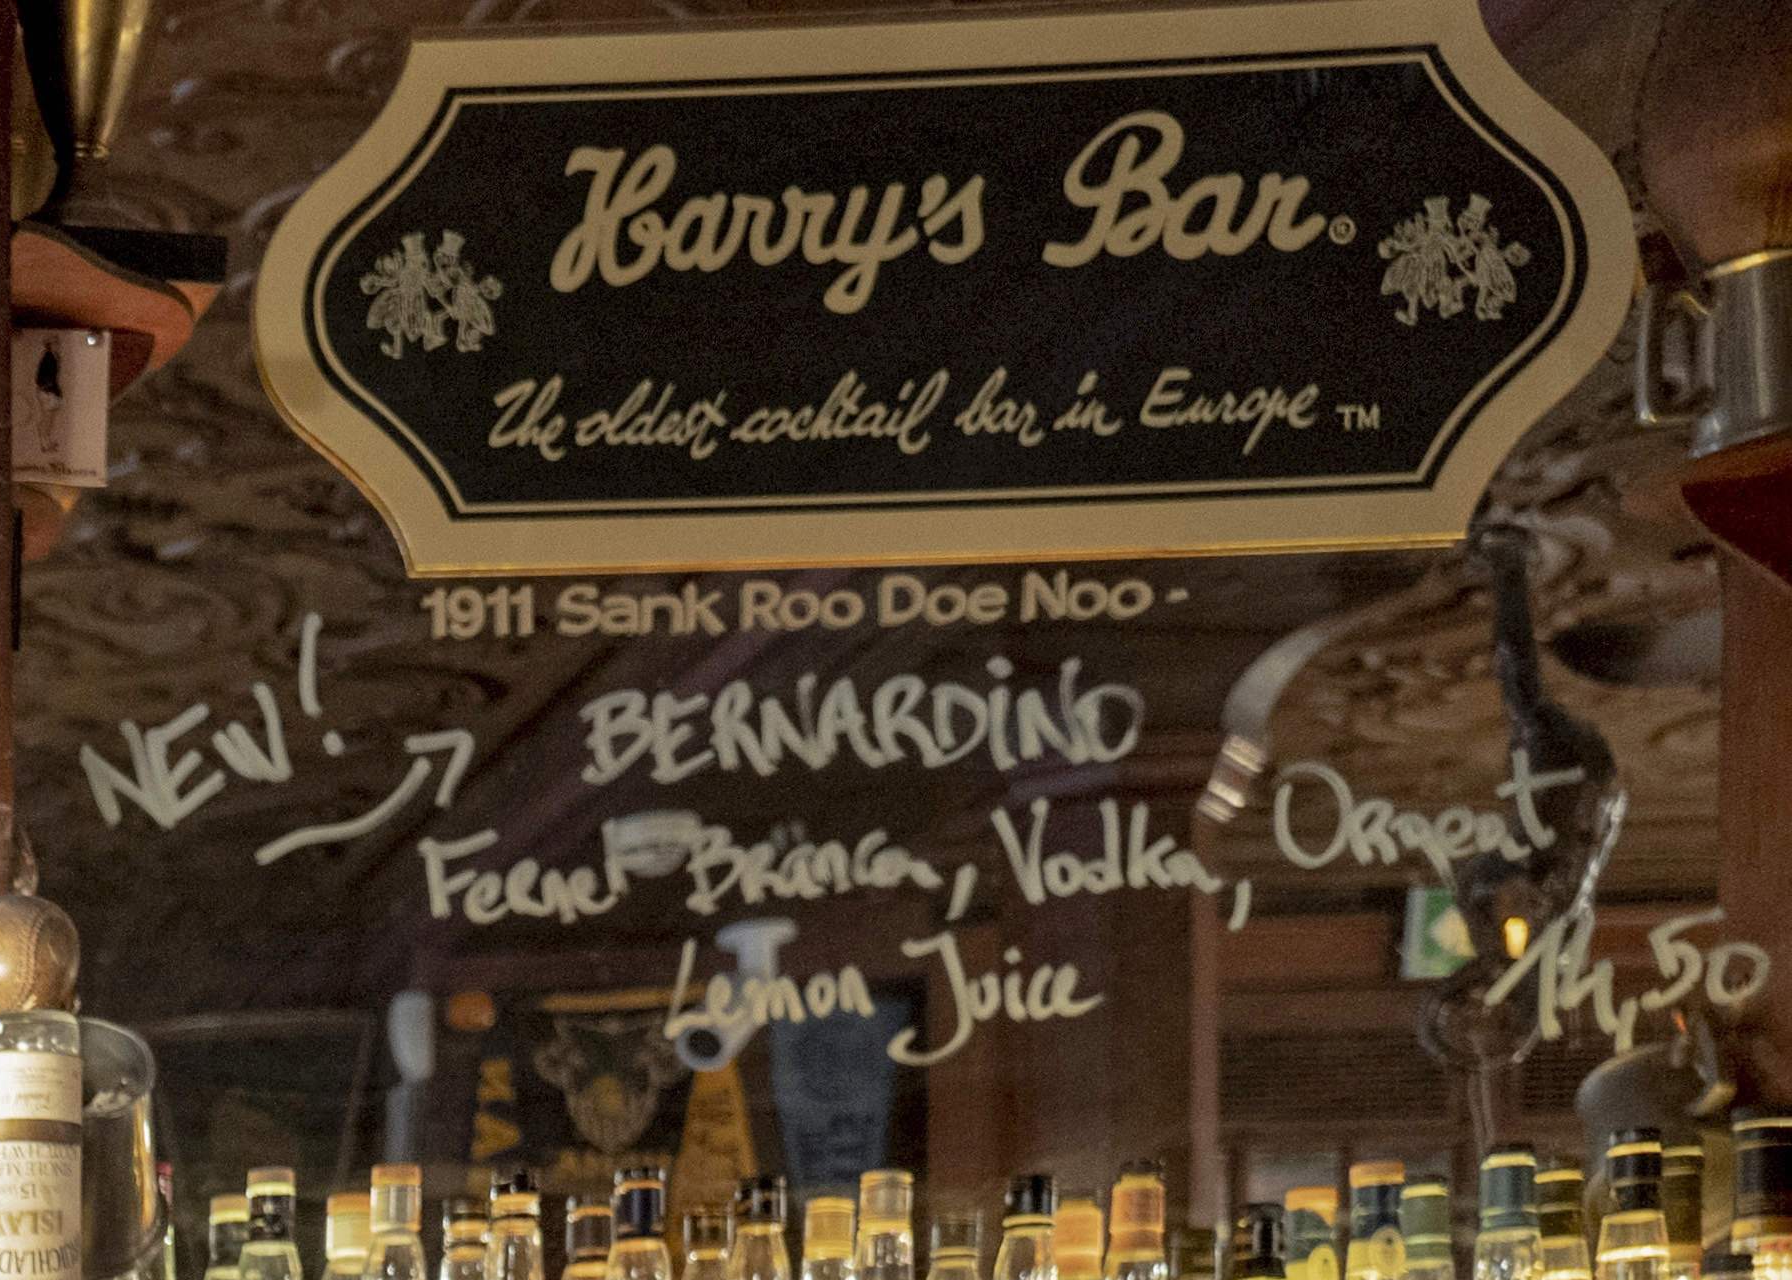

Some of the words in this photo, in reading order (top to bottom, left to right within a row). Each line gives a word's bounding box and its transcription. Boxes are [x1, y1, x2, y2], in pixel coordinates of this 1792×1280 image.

[550, 144, 985, 314] Harry's
[489, 375, 566, 461] The
[576, 379, 727, 459] oldest
[731, 370, 950, 455] cocktail
[955, 367, 1044, 445] bar
[1054, 370, 1122, 435] in
[1140, 367, 1319, 455] Europe
[421, 584, 537, 638] 1911
[558, 582, 725, 638] Sank
[741, 578, 864, 634] Roo
[878, 571, 1008, 627] Doe
[1021, 570, 1152, 620] Noo
[665, 939, 874, 1039] Lemon
[889, 930, 1104, 1065] Juice
